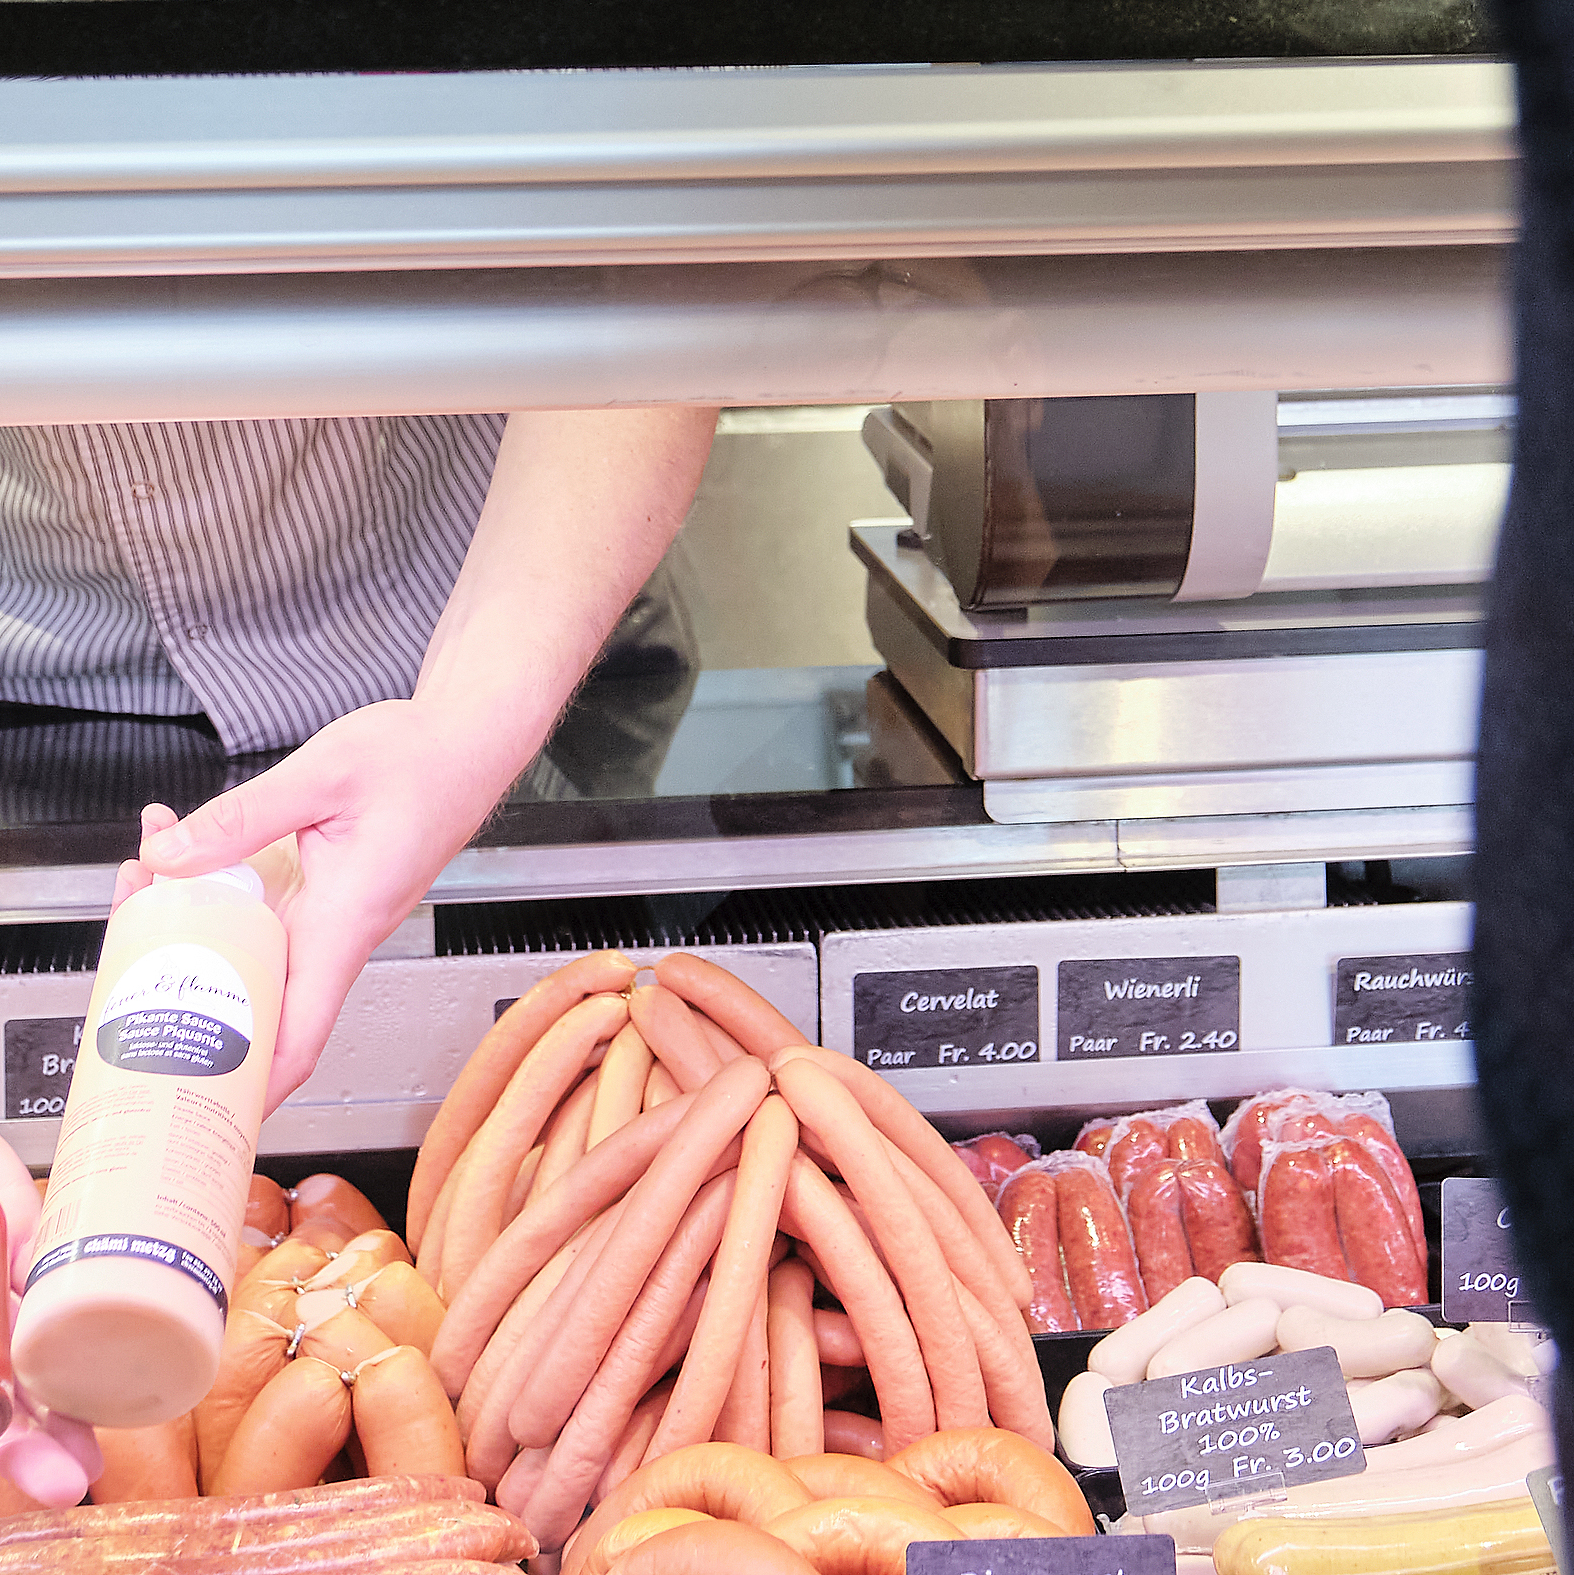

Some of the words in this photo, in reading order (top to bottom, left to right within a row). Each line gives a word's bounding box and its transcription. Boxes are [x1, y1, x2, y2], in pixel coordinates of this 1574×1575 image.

[155, 975, 175, 992] &
[178, 975, 249, 1007] flamme
[900, 988, 1000, 1013] Cervelat
[1104, 976, 1201, 1001] Wienerli
[125, 1011, 178, 1027] Pikante
[180, 1012, 223, 1035] Sauce
[1345, 1026, 1394, 1043] Paar
[1415, 1021, 1447, 1040] Fr.
[118, 1025, 160, 1042] Sauce
[162, 1024, 224, 1050] Piquante
[1069, 1035, 1119, 1052] Paar
[1139, 1031, 1171, 1051] Fr.
[1178, 1030, 1237, 1050] 2.40
[866, 1049, 916, 1066] Paar
[938, 1043, 969, 1064] Fr.
[978, 1041, 1037, 1061] 4.00
[19, 1097, 65, 1115] 100
[1458, 1272, 1520, 1298] 100g
[1181, 1365, 1274, 1399] Kalbs-
[1159, 1385, 1312, 1435] Bratwurst
[1197, 1423, 1281, 1456] 100%
[1141, 1469, 1211, 1496] 100g
[1232, 1456, 1272, 1478] Fr.
[1282, 1437, 1357, 1468] 3.00
